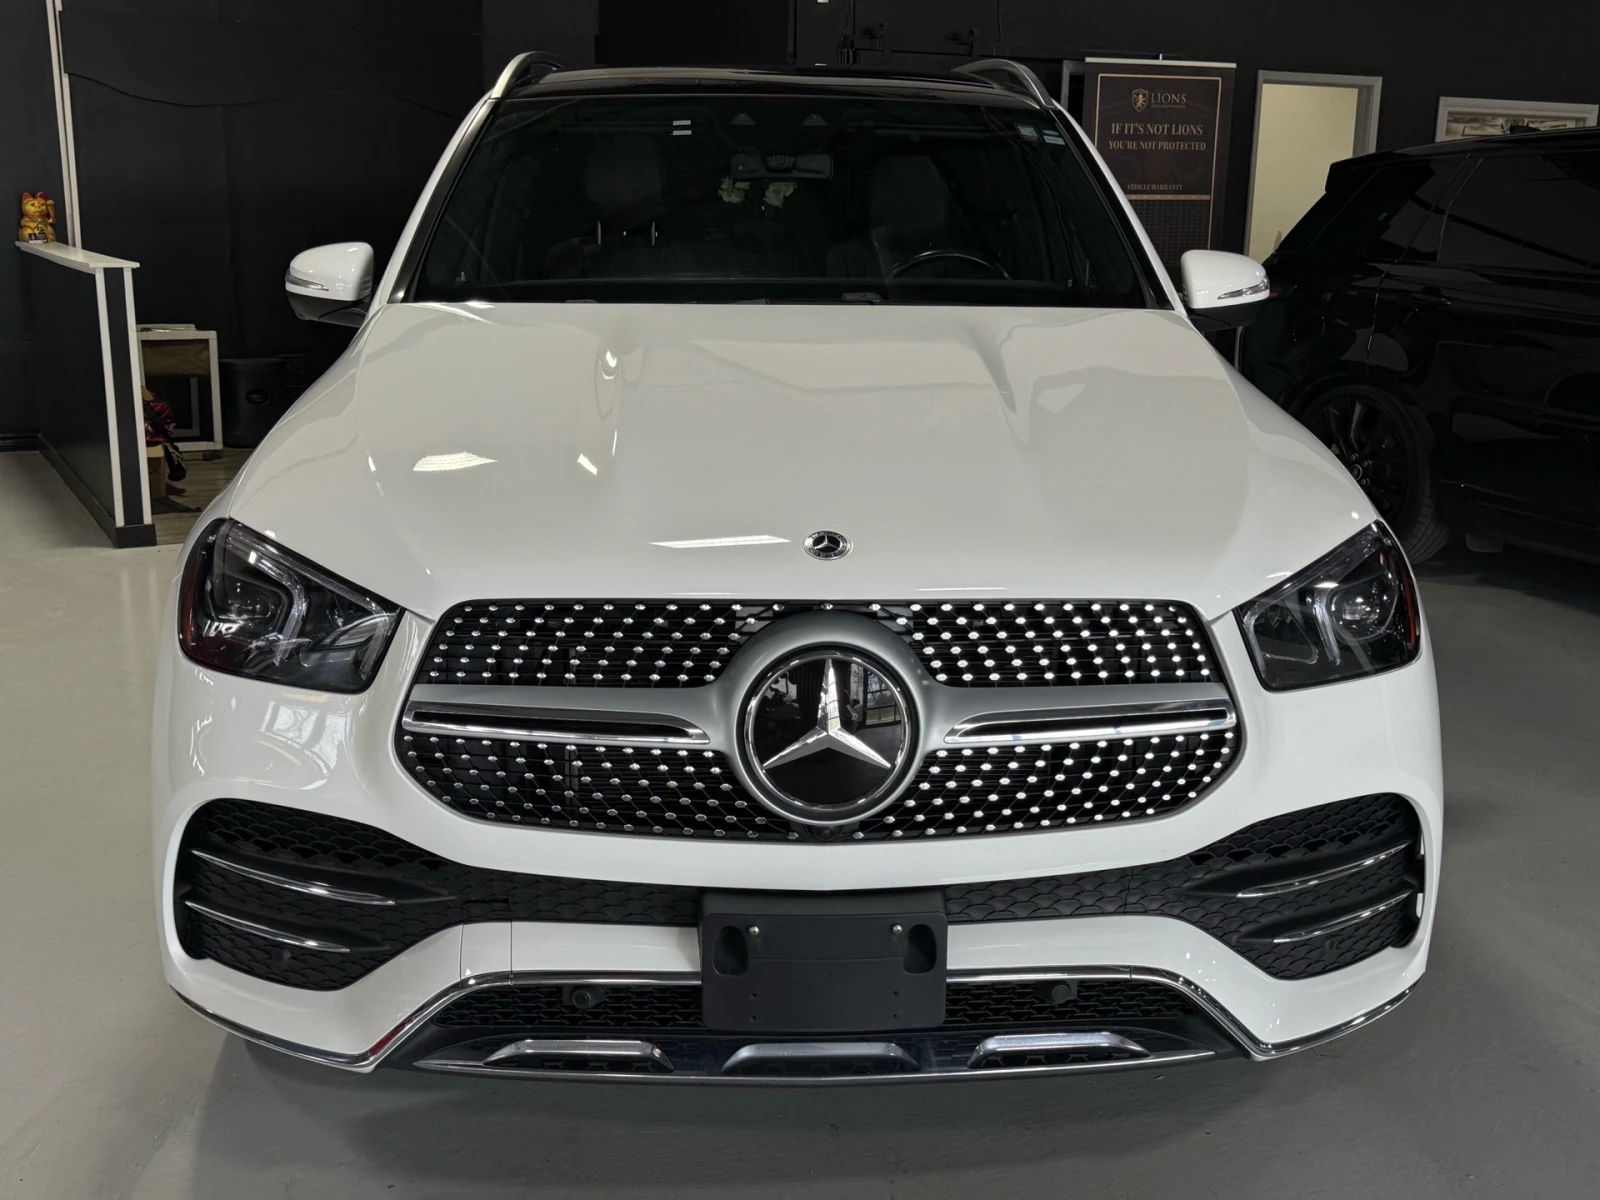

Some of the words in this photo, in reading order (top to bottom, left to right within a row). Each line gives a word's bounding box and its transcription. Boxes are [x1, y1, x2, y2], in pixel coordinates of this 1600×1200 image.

[1151, 92, 1187, 104] LIONS
[1111, 122, 1123, 135] IF
[1124, 122, 1144, 135] IT'S
[1146, 123, 1170, 135] NOT
[1171, 124, 1204, 136] LIONS
[1108, 140, 1138, 150] YOU'RE
[1140, 140, 1158, 150] NOT
[1158, 141, 1206, 151] PROTECTED
[1151, 183, 1183, 191] WARRANTY
